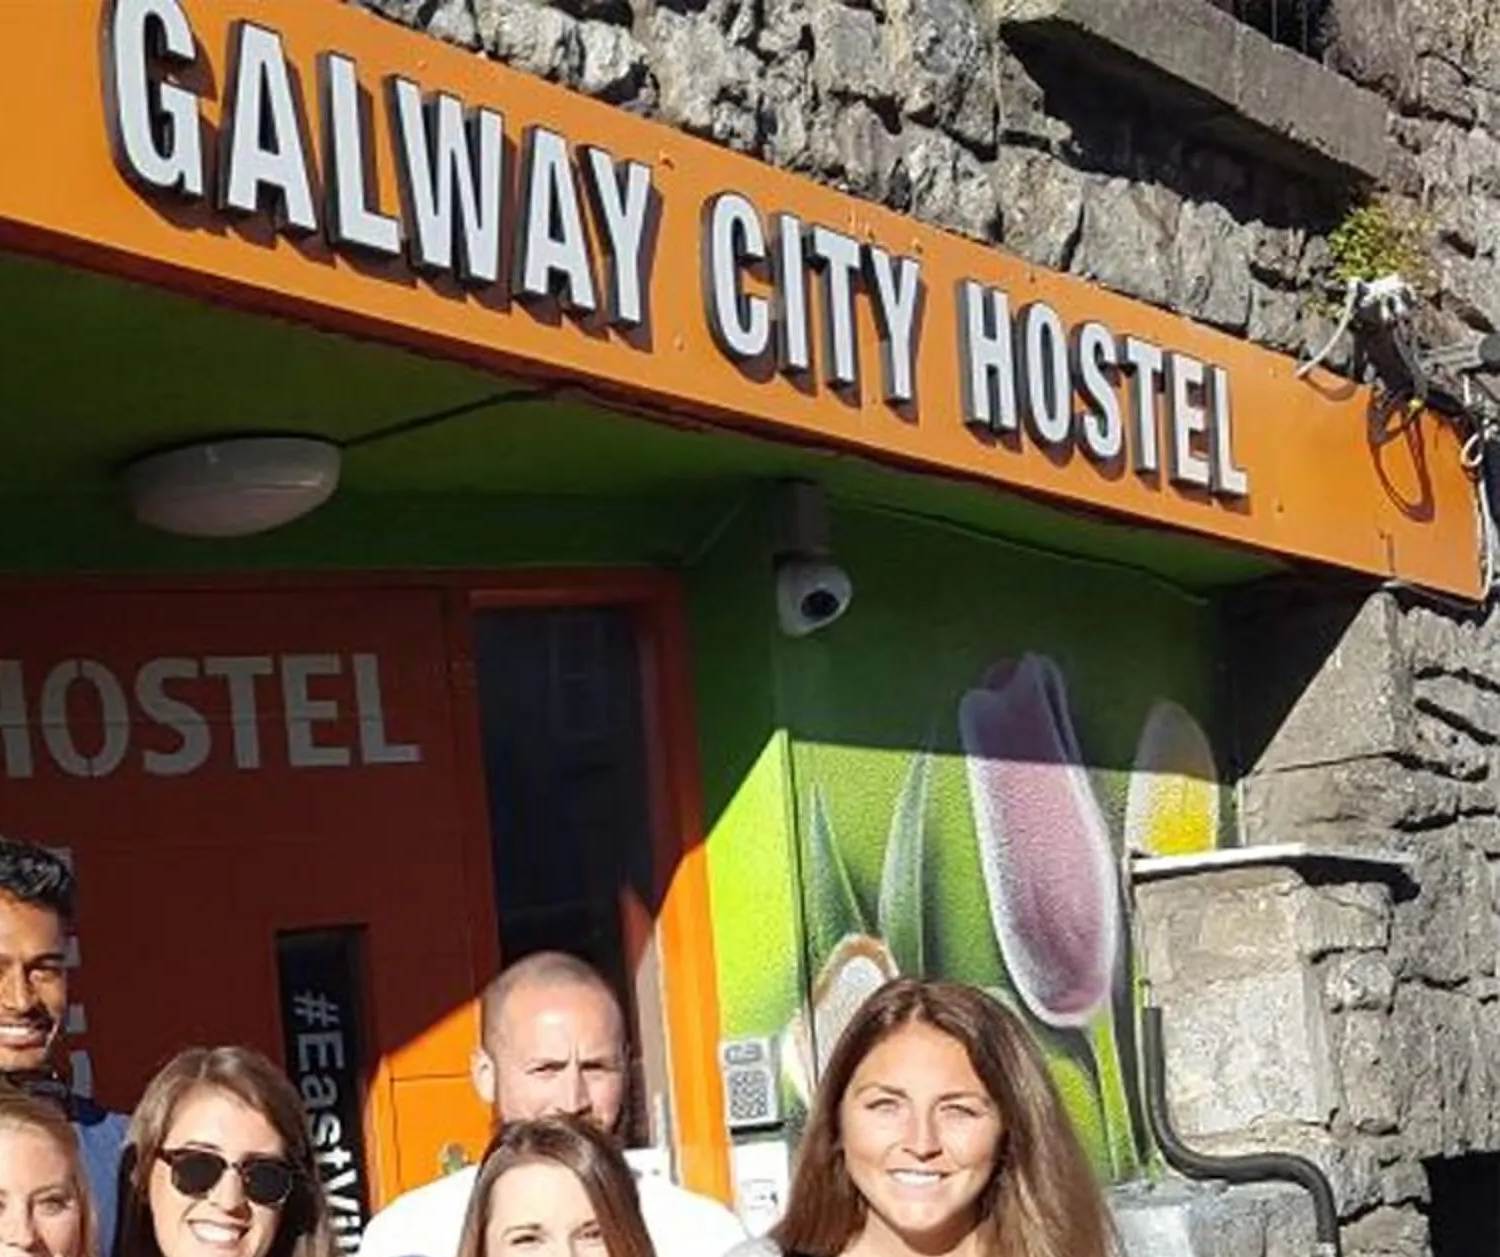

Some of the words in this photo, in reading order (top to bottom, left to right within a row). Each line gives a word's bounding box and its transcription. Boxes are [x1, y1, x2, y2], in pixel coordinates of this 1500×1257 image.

[104, 0, 653, 327] GALWAY
[704, 190, 922, 402] CITY
[958, 278, 1250, 498] HOSTEL
